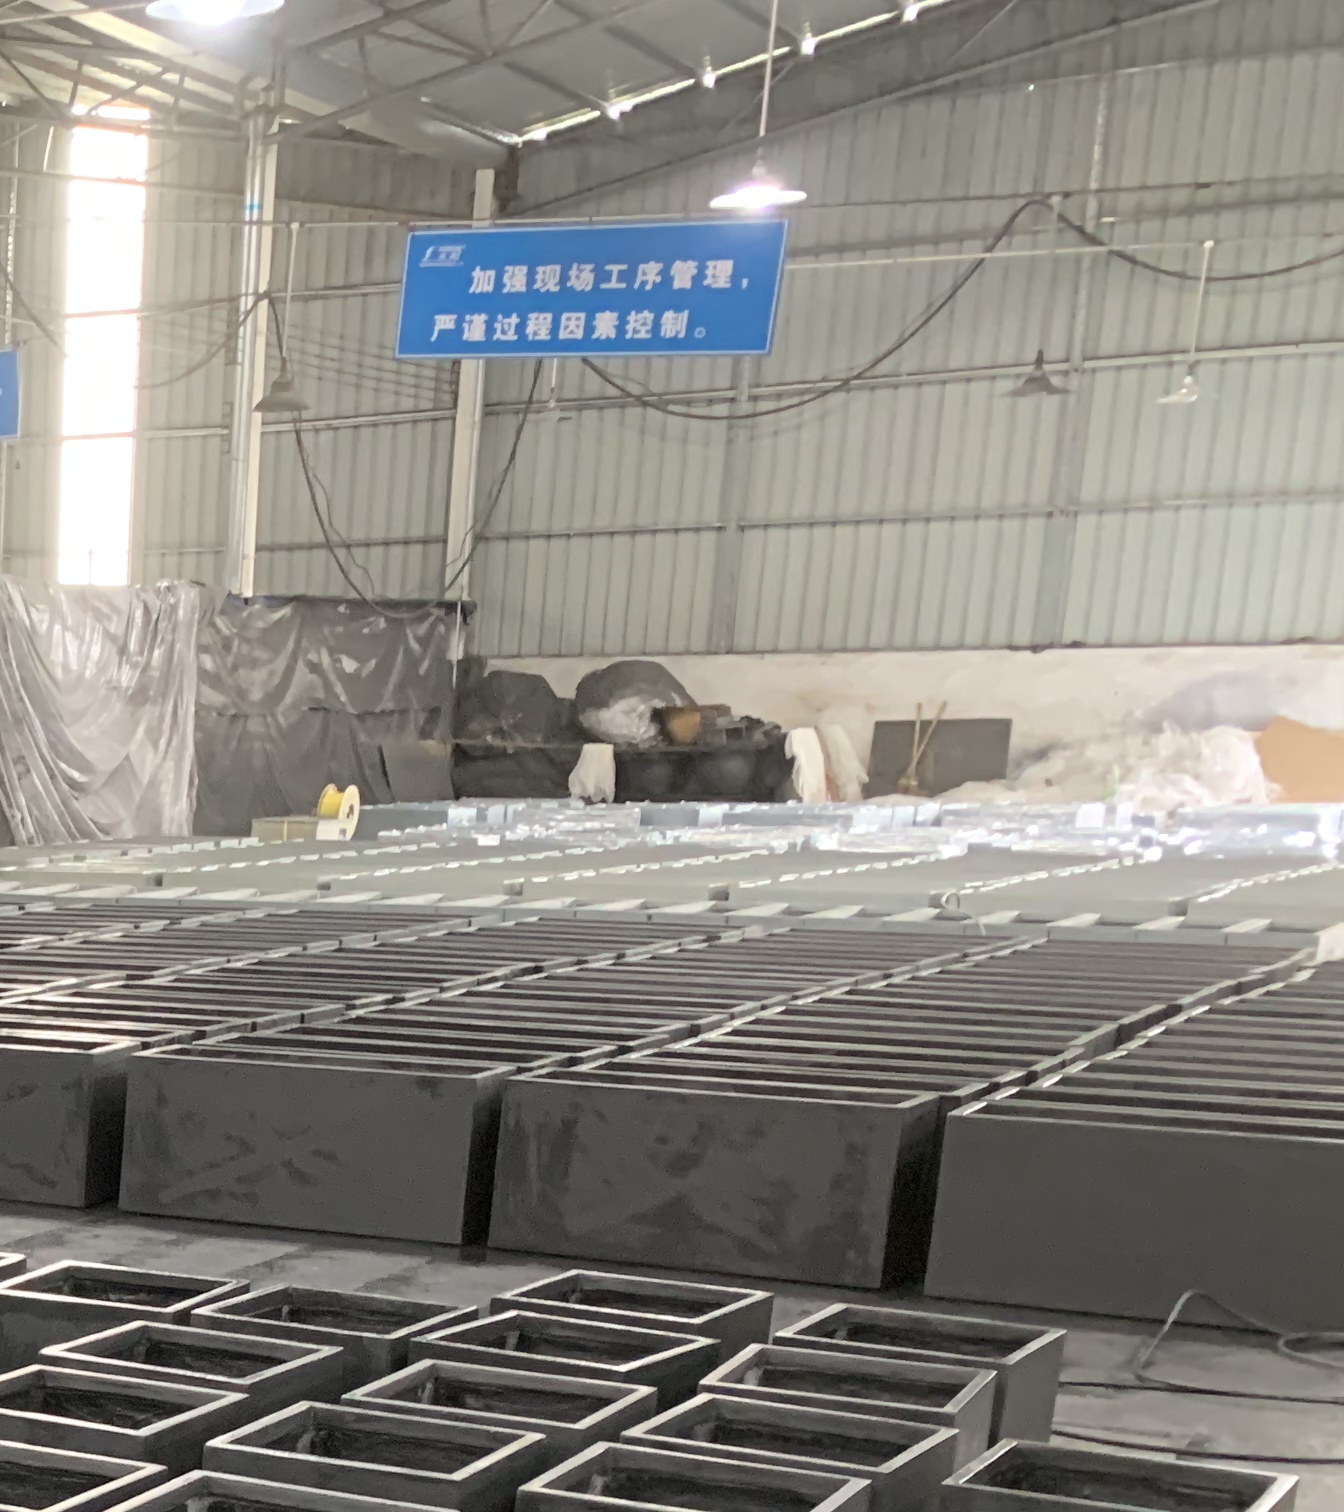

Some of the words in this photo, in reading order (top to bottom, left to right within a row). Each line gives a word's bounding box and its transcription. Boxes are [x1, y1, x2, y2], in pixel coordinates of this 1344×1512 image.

[468, 259, 750, 295] 加强现场工序管理，
[430, 308, 707, 343] 严谨过程因素控制。
